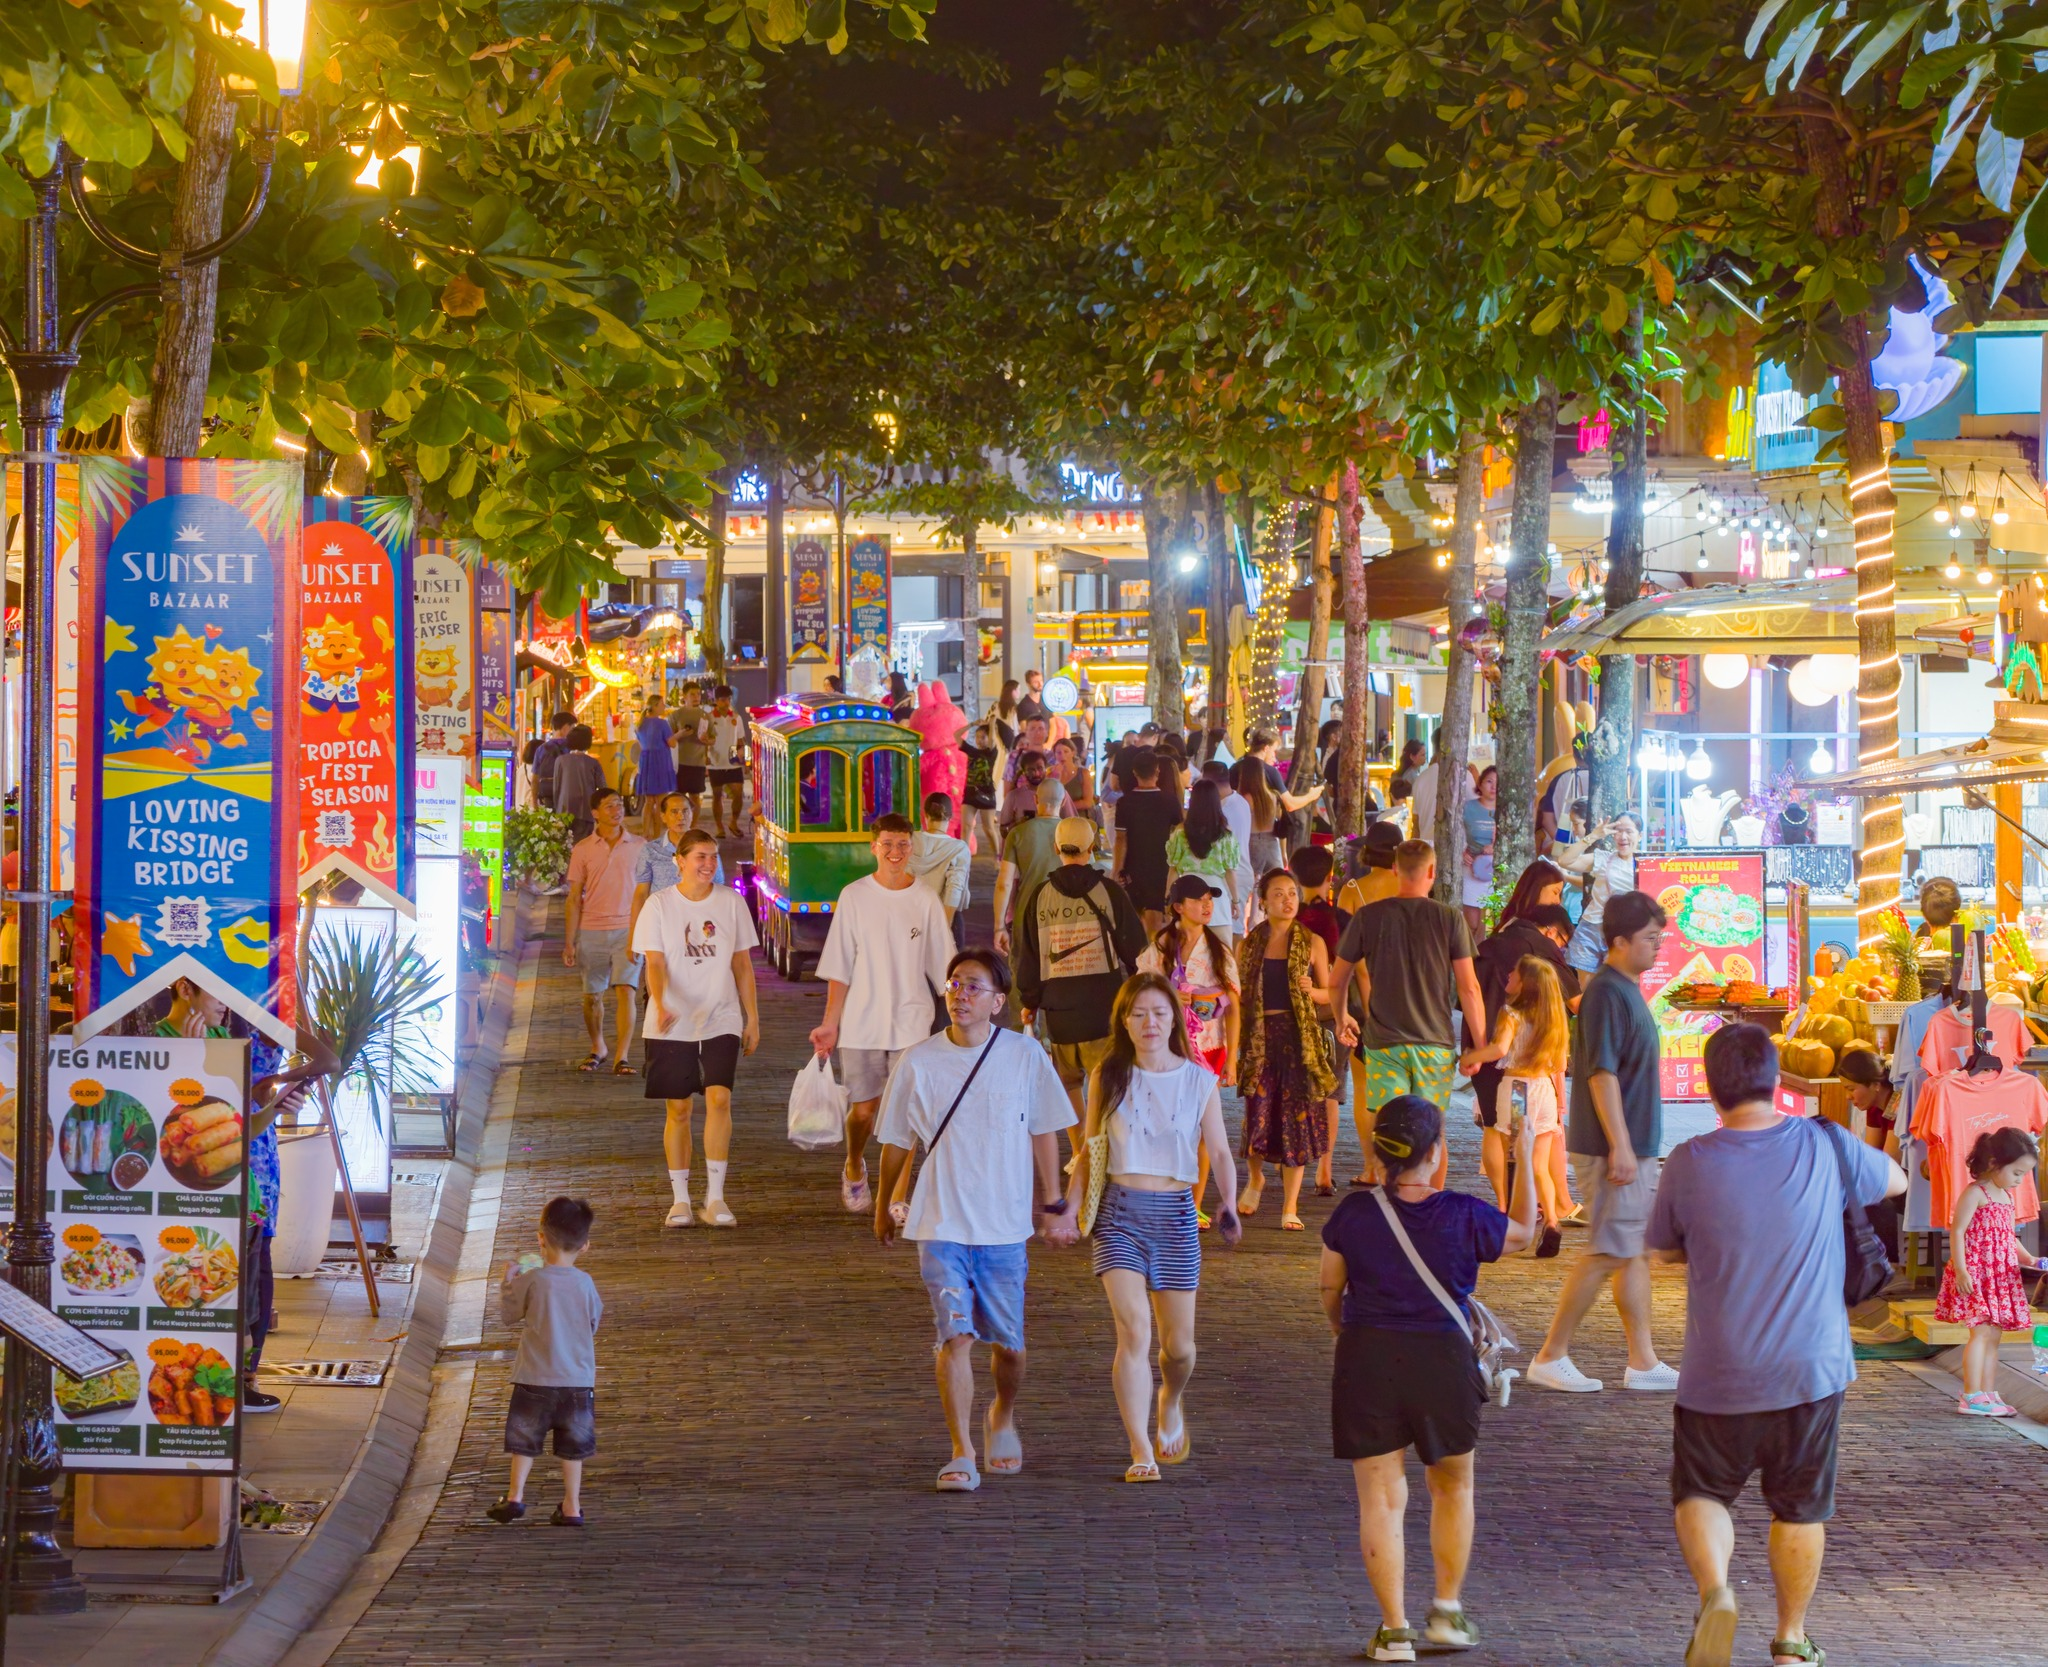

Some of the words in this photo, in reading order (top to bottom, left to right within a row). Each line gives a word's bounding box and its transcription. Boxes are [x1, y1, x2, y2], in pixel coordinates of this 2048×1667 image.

[122, 552, 258, 584] SUNSET
[302, 563, 382, 586] UNSET
[414, 579, 462, 593] UNSET
[481, 585, 501, 596] SET
[149, 591, 230, 609] BAZAAR
[304, 592, 362, 604] BAZAAR
[419, 610, 448, 625] ERIC
[797, 619, 811, 628] THE
[812, 620, 825, 629] SEA
[490, 657, 497, 667] 2
[482, 667, 501, 677] GHT
[415, 713, 467, 728] ASTING
[321, 763, 373, 782] FEST
[299, 775, 316, 791] ST
[311, 784, 389, 807] SEASON
[129, 798, 240, 824] LOVING
[127, 826, 249, 861] KISSING
[134, 860, 235, 886] BRIDGE
[1659, 860, 1739, 872] VIETNAMESE
[1680, 873, 1720, 884] ROLLS
[1662, 891, 1679, 905] Only
[1732, 959, 1748, 975] Only
[96, 1050, 170, 1070] MENU
[178, 1206, 200, 1214] Vegan
[201, 1206, 221, 1214] Popia
[69, 1318, 91, 1326] Vegan
[160, 1448, 198, 1456] lemongrass
